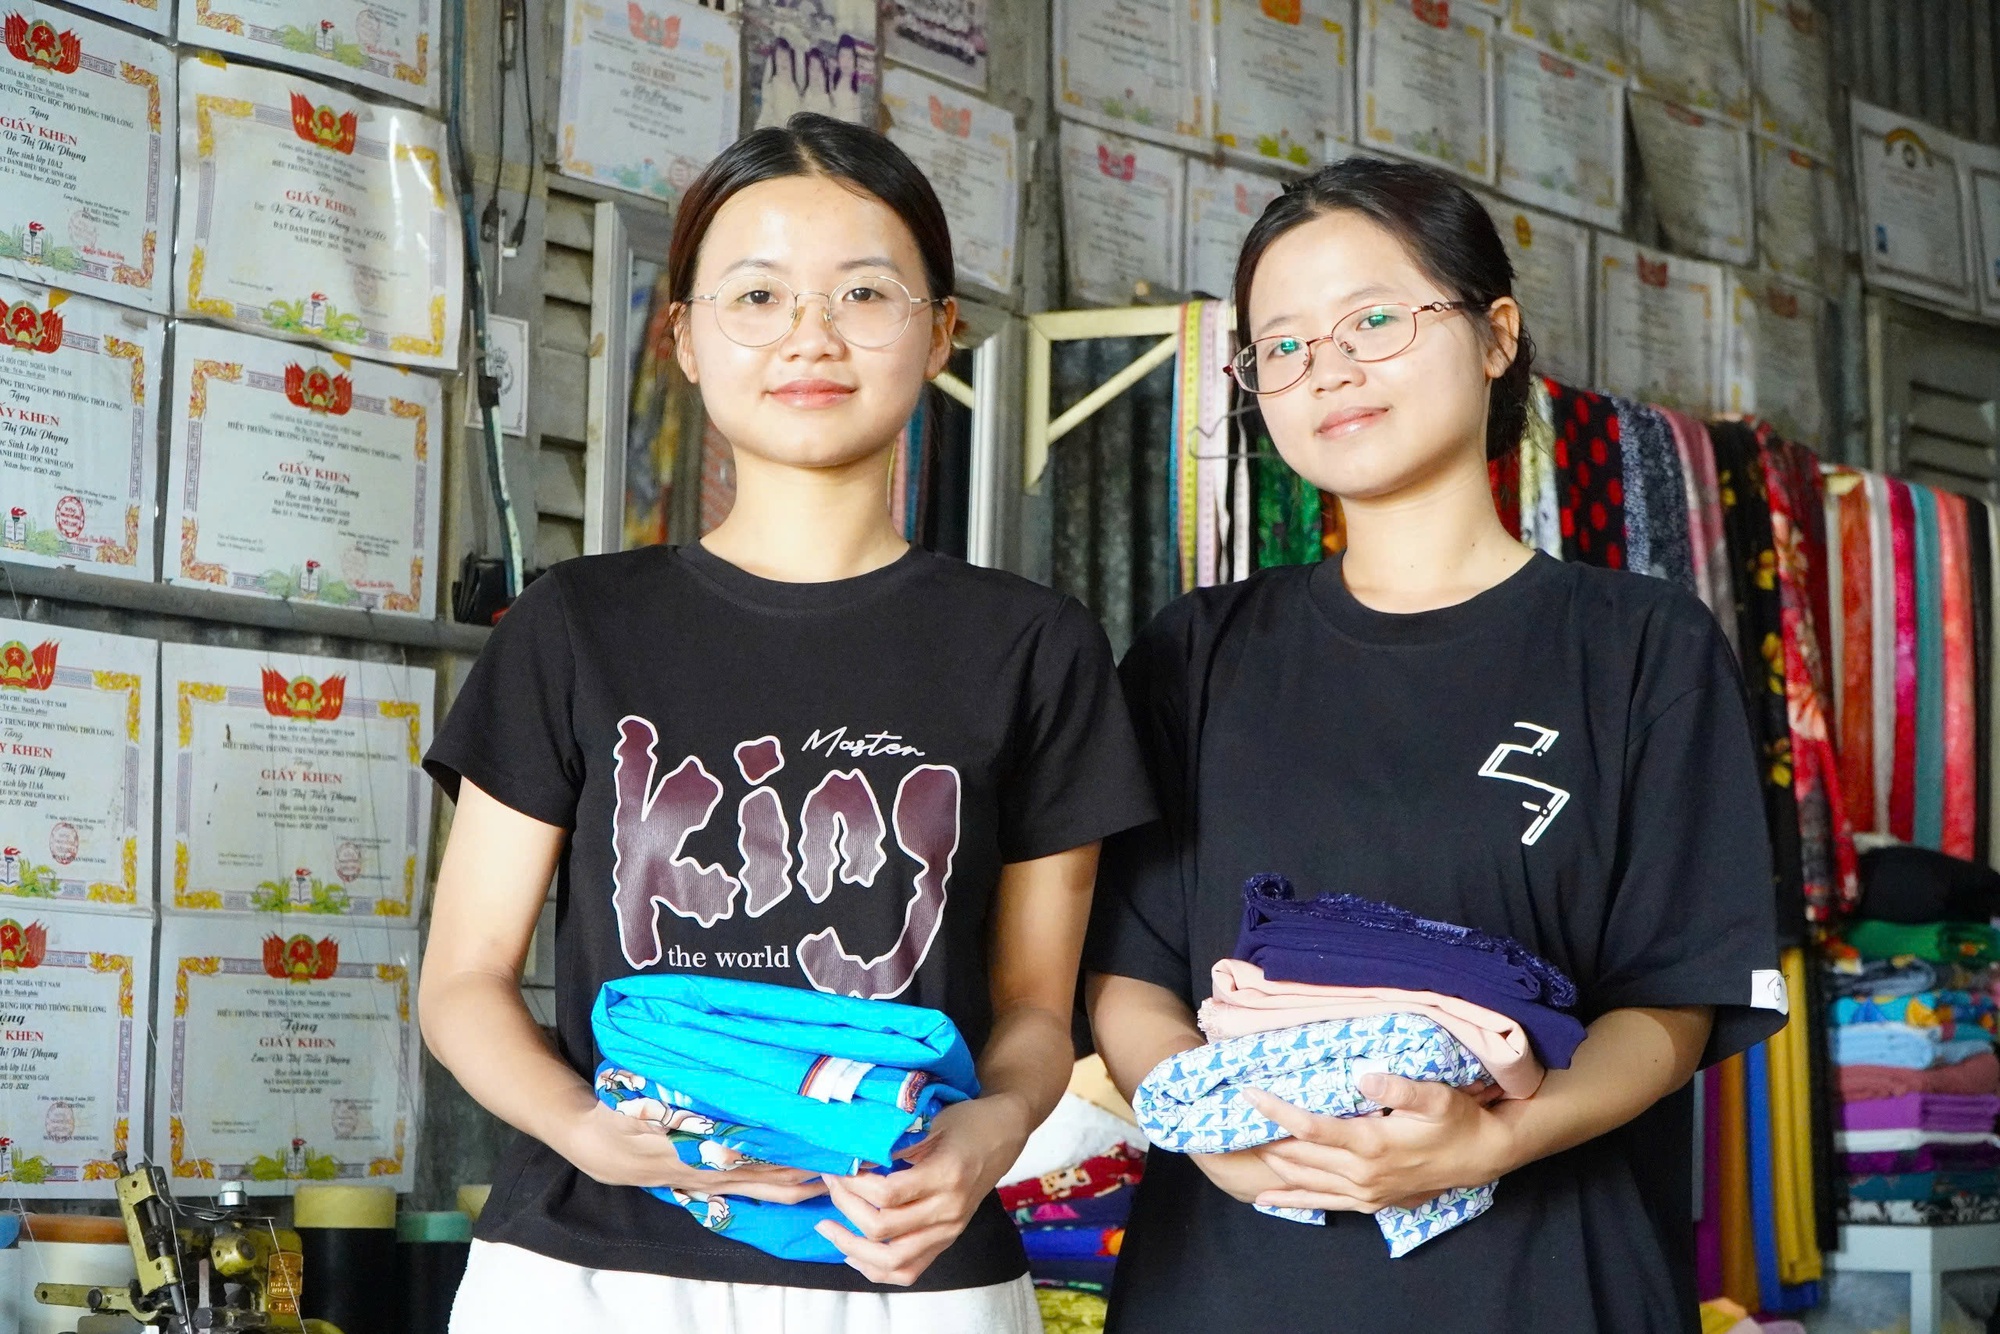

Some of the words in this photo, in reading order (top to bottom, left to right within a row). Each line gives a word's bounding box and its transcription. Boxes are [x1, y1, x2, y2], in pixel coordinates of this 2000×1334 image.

[0, 116, 35, 134] GIẤY
[40, 126, 78, 146] KHEN
[21, 134, 36, 149] Thị
[286, 190, 321, 206] GIẤY
[325, 198, 357, 218] KHEN
[37, 386, 51, 395] HỌC
[20, 410, 60, 427] KHEN
[279, 461, 311, 476] GIẤY
[316, 468, 350, 483] KHEN
[12, 744, 53, 759] KHEN
[262, 766, 296, 781] GIẤY
[303, 771, 342, 784] KHEN
[667, 945, 707, 968] the
[715, 945, 790, 969] world
[6, 1030, 44, 1042] KHEN
[260, 1033, 294, 1048] GIẤY
[298, 1038, 336, 1049] KHEN
